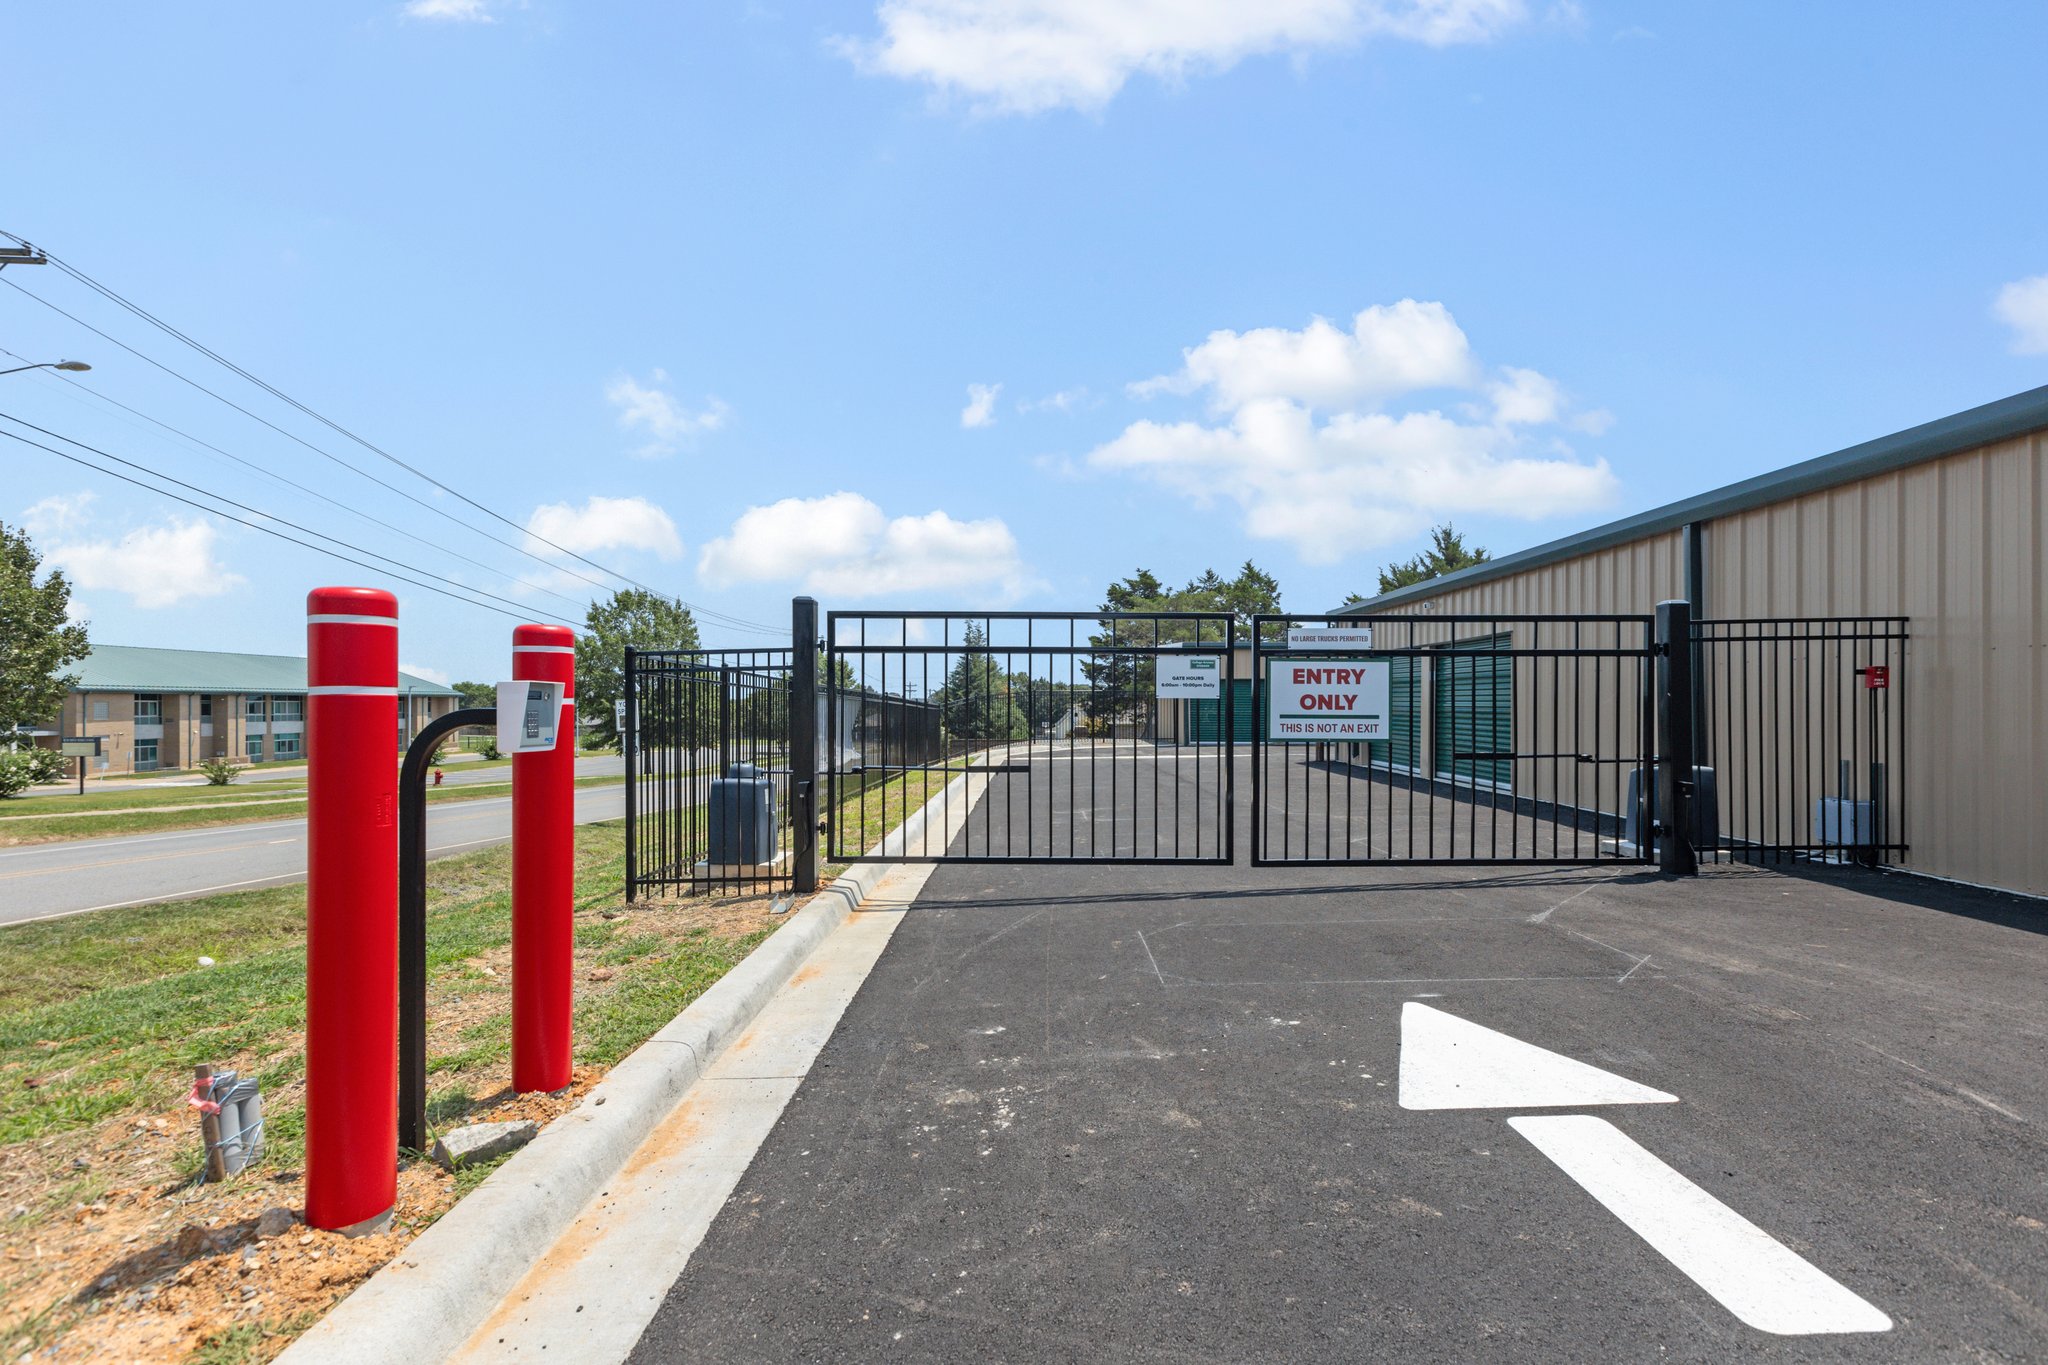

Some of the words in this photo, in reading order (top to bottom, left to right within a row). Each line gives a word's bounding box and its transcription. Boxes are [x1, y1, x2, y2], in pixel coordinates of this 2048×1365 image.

[1292, 668, 1366, 684] ENTRY
[1299, 694, 1358, 710] ONLY
[1280, 723, 1302, 733] THIS
[1304, 723, 1314, 733] IS
[1317, 723, 1338, 733] NOT
[1340, 723, 1354, 733] AN
[1357, 723, 1380, 733] EXIT
